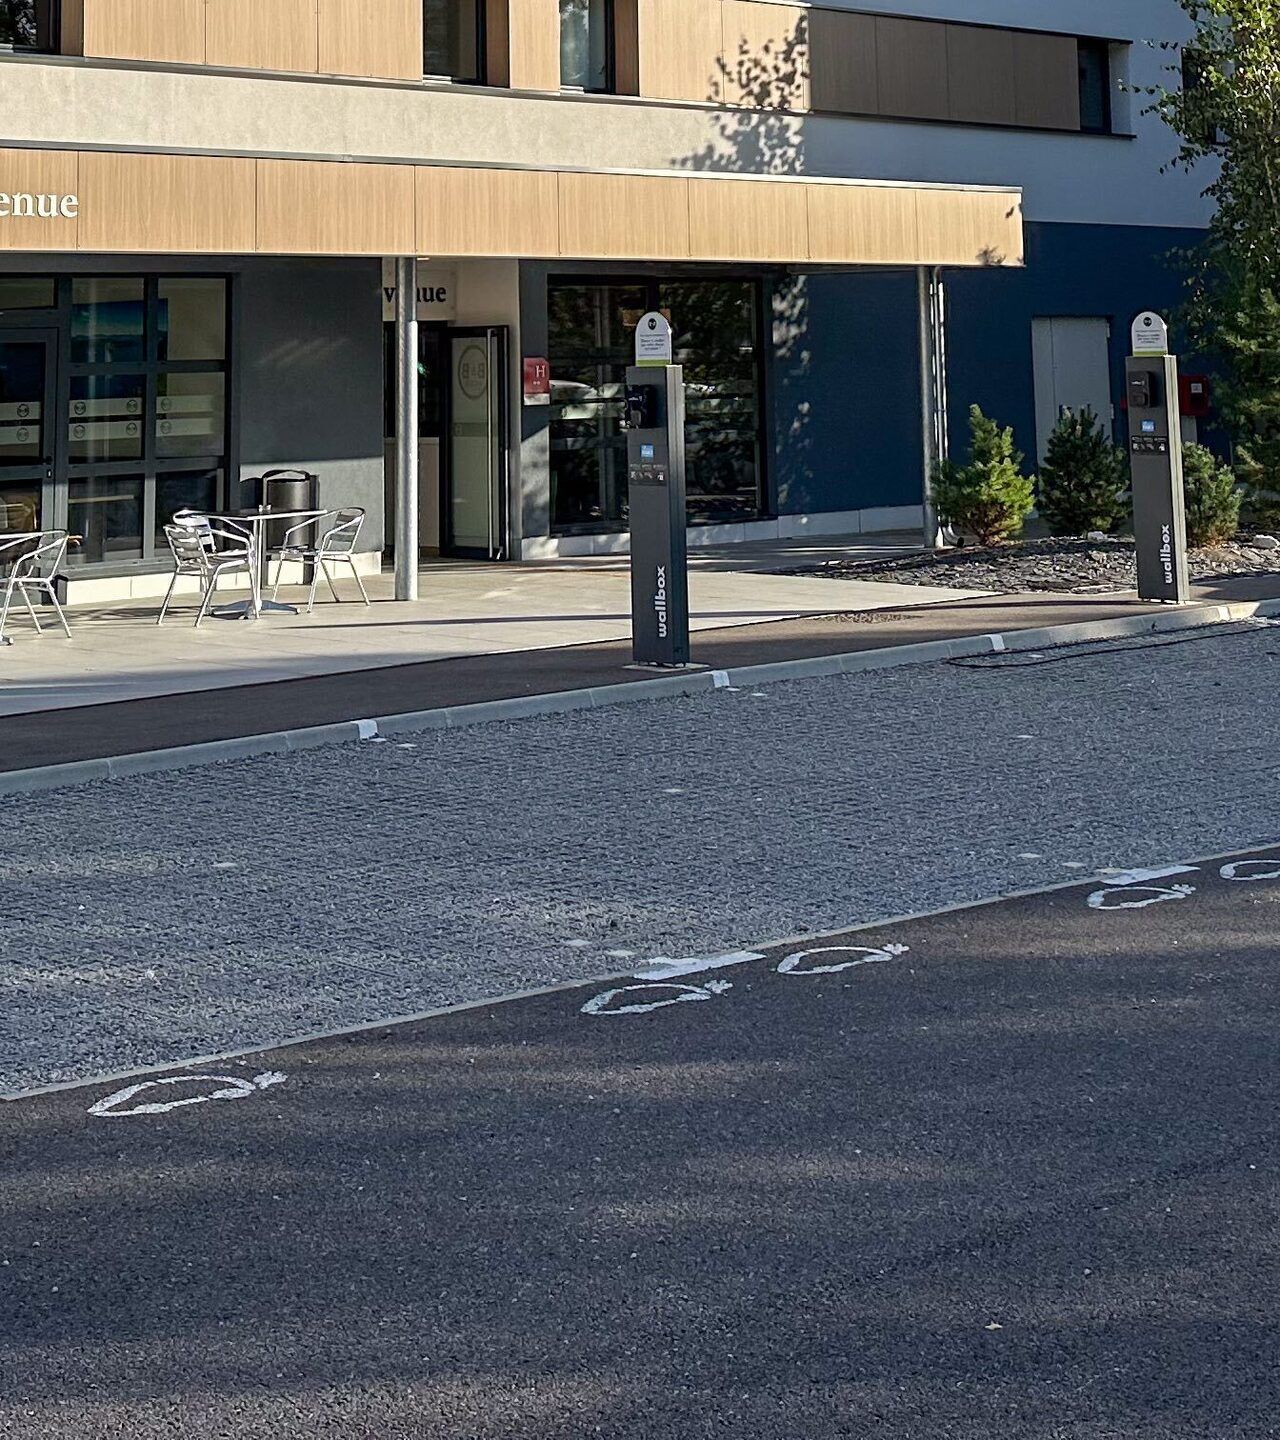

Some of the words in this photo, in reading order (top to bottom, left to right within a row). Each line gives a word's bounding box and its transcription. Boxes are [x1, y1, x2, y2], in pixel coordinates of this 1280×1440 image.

[535, 365, 546, 378] H
[1160, 524, 1173, 584] wallbox
[655, 565, 667, 638] wallbox
